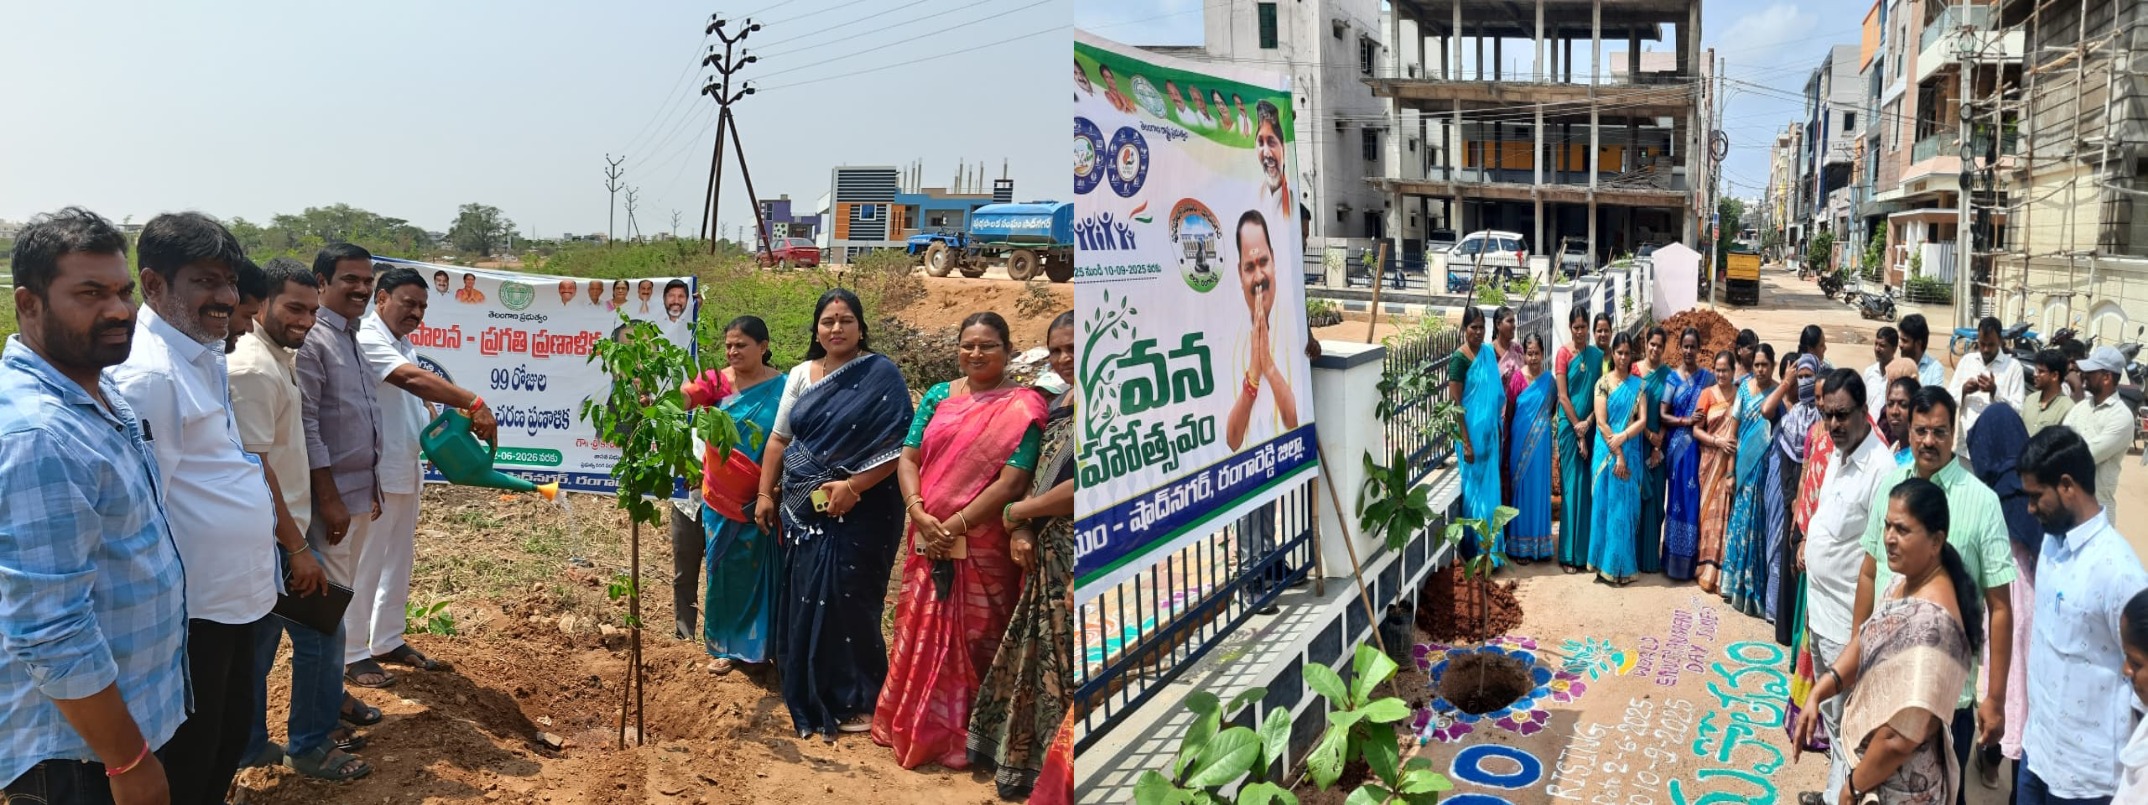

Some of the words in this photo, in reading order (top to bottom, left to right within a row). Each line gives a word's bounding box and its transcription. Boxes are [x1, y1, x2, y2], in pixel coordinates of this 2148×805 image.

[1105, 264, 1146, 276] 10-09-2025
[488, 310, 519, 320] తెలంగాణ
[520, 312, 548, 324] ప్రభుత్వం
[407, 321, 461, 349] పాలన
[480, 326, 528, 356] ప్రగతి
[490, 368, 509, 391] 99
[511, 363, 547, 392] రోజుల
[1117, 332, 1215, 416] వన
[528, 406, 570, 437] ప్రణాళిక
[1218, 443, 1275, 491] రంగారెడ్డి
[1685, 644, 1708, 673] DAY
[1546, 722, 1614, 800] RISING
